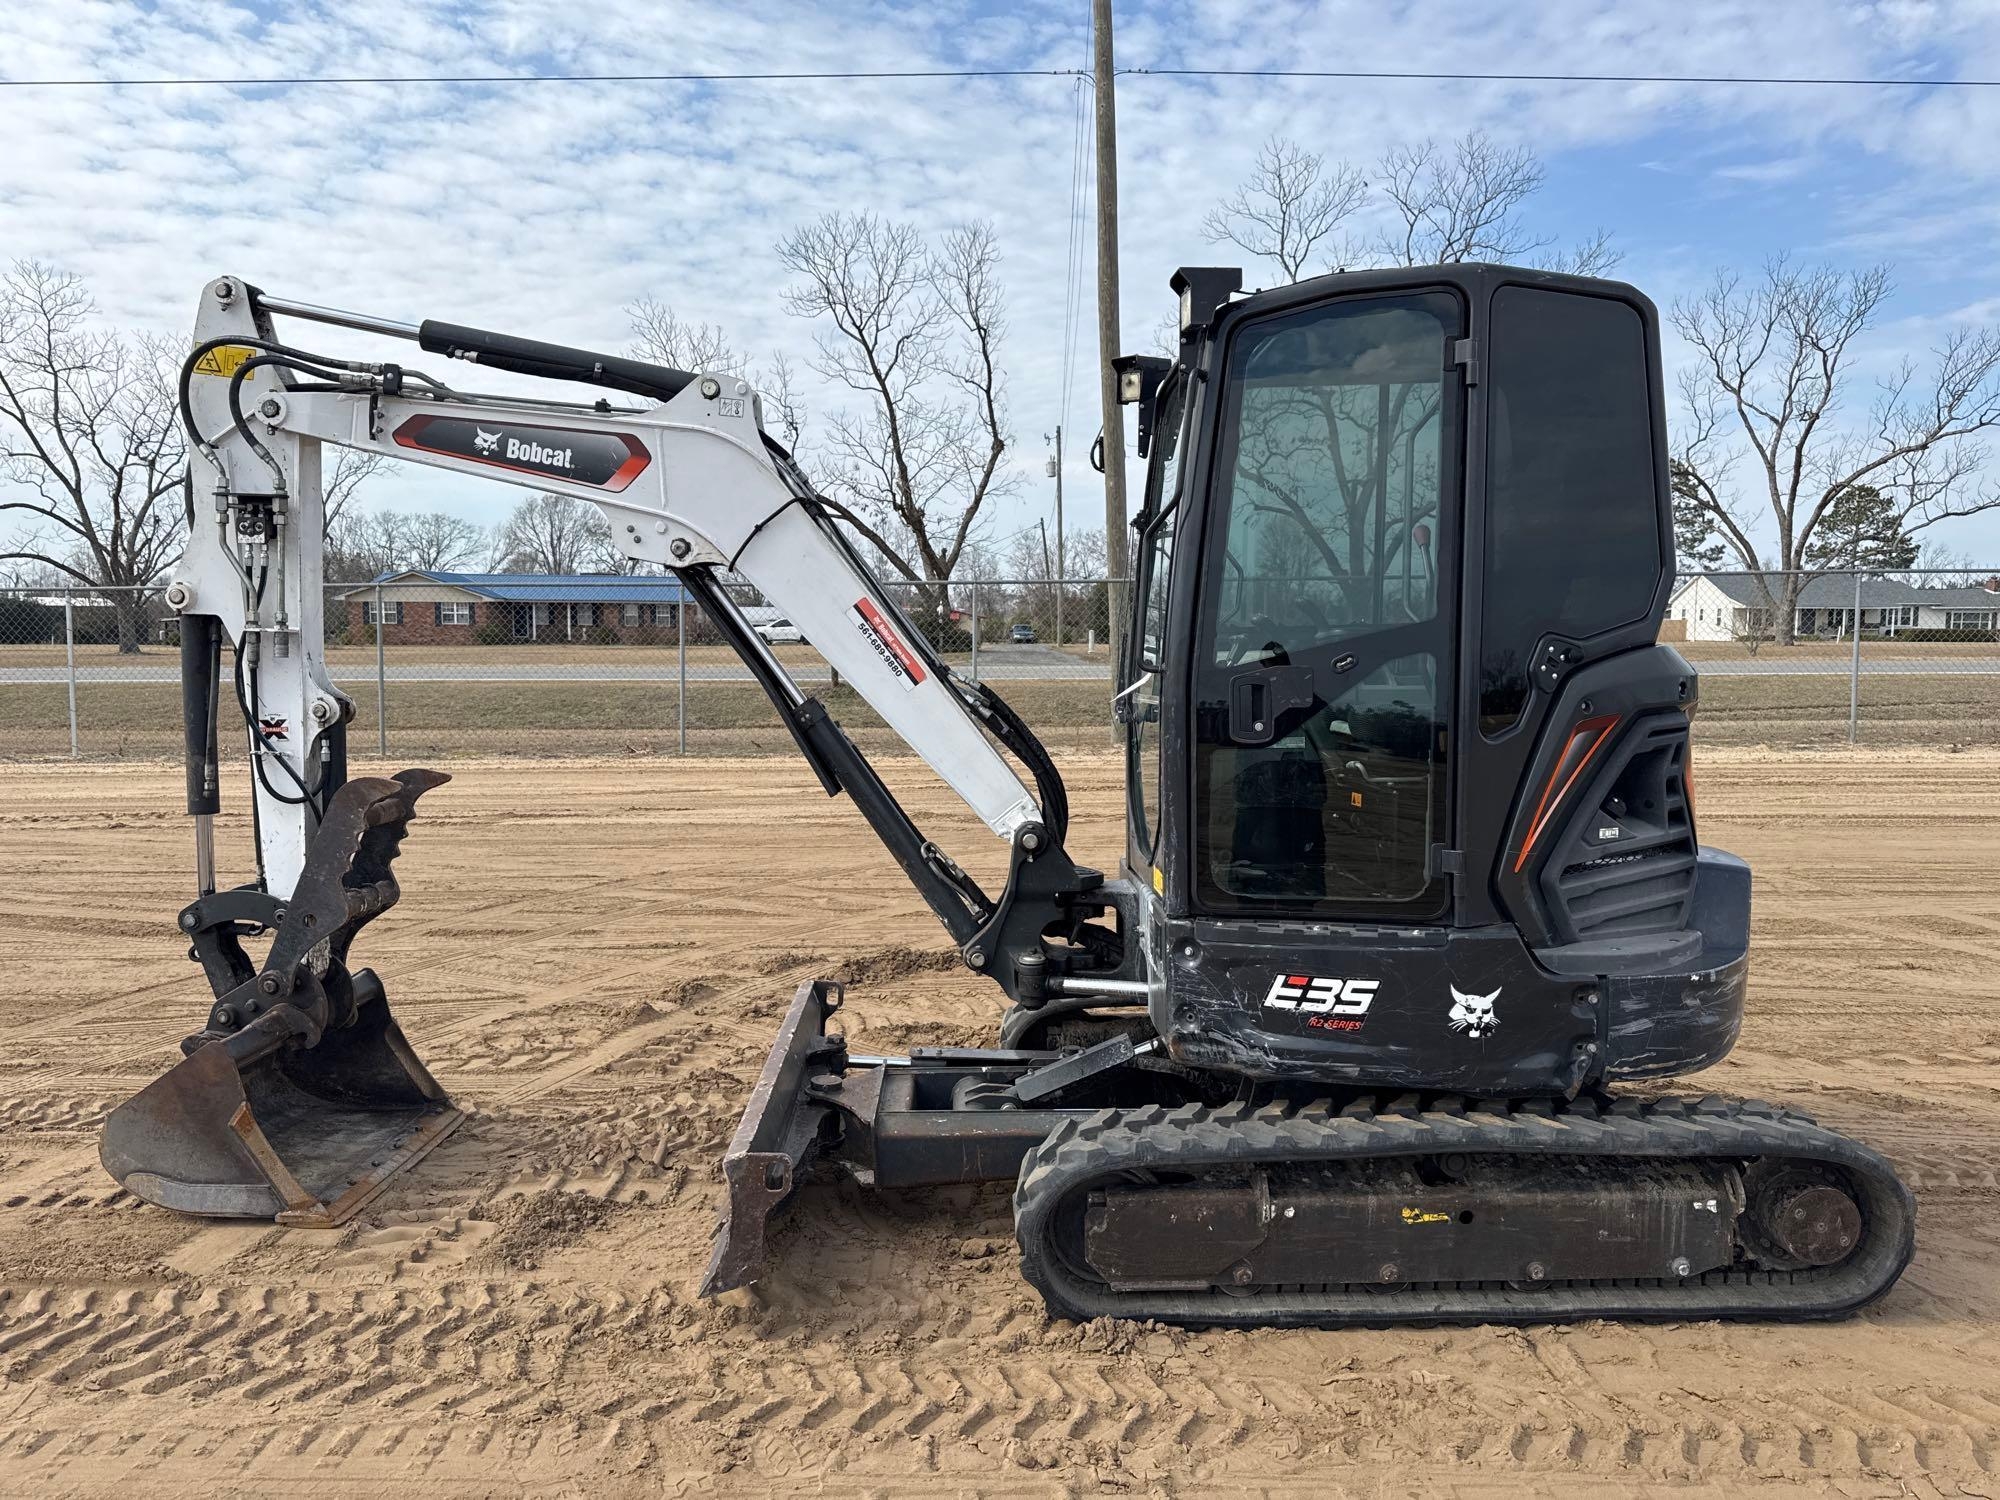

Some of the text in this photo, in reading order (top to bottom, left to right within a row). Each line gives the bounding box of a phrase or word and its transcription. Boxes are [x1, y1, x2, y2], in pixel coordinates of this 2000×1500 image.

[506, 438, 572, 469] Bobcat
[857, 622, 903, 677] 561-689-9880
[1263, 974, 1381, 1015] E35
